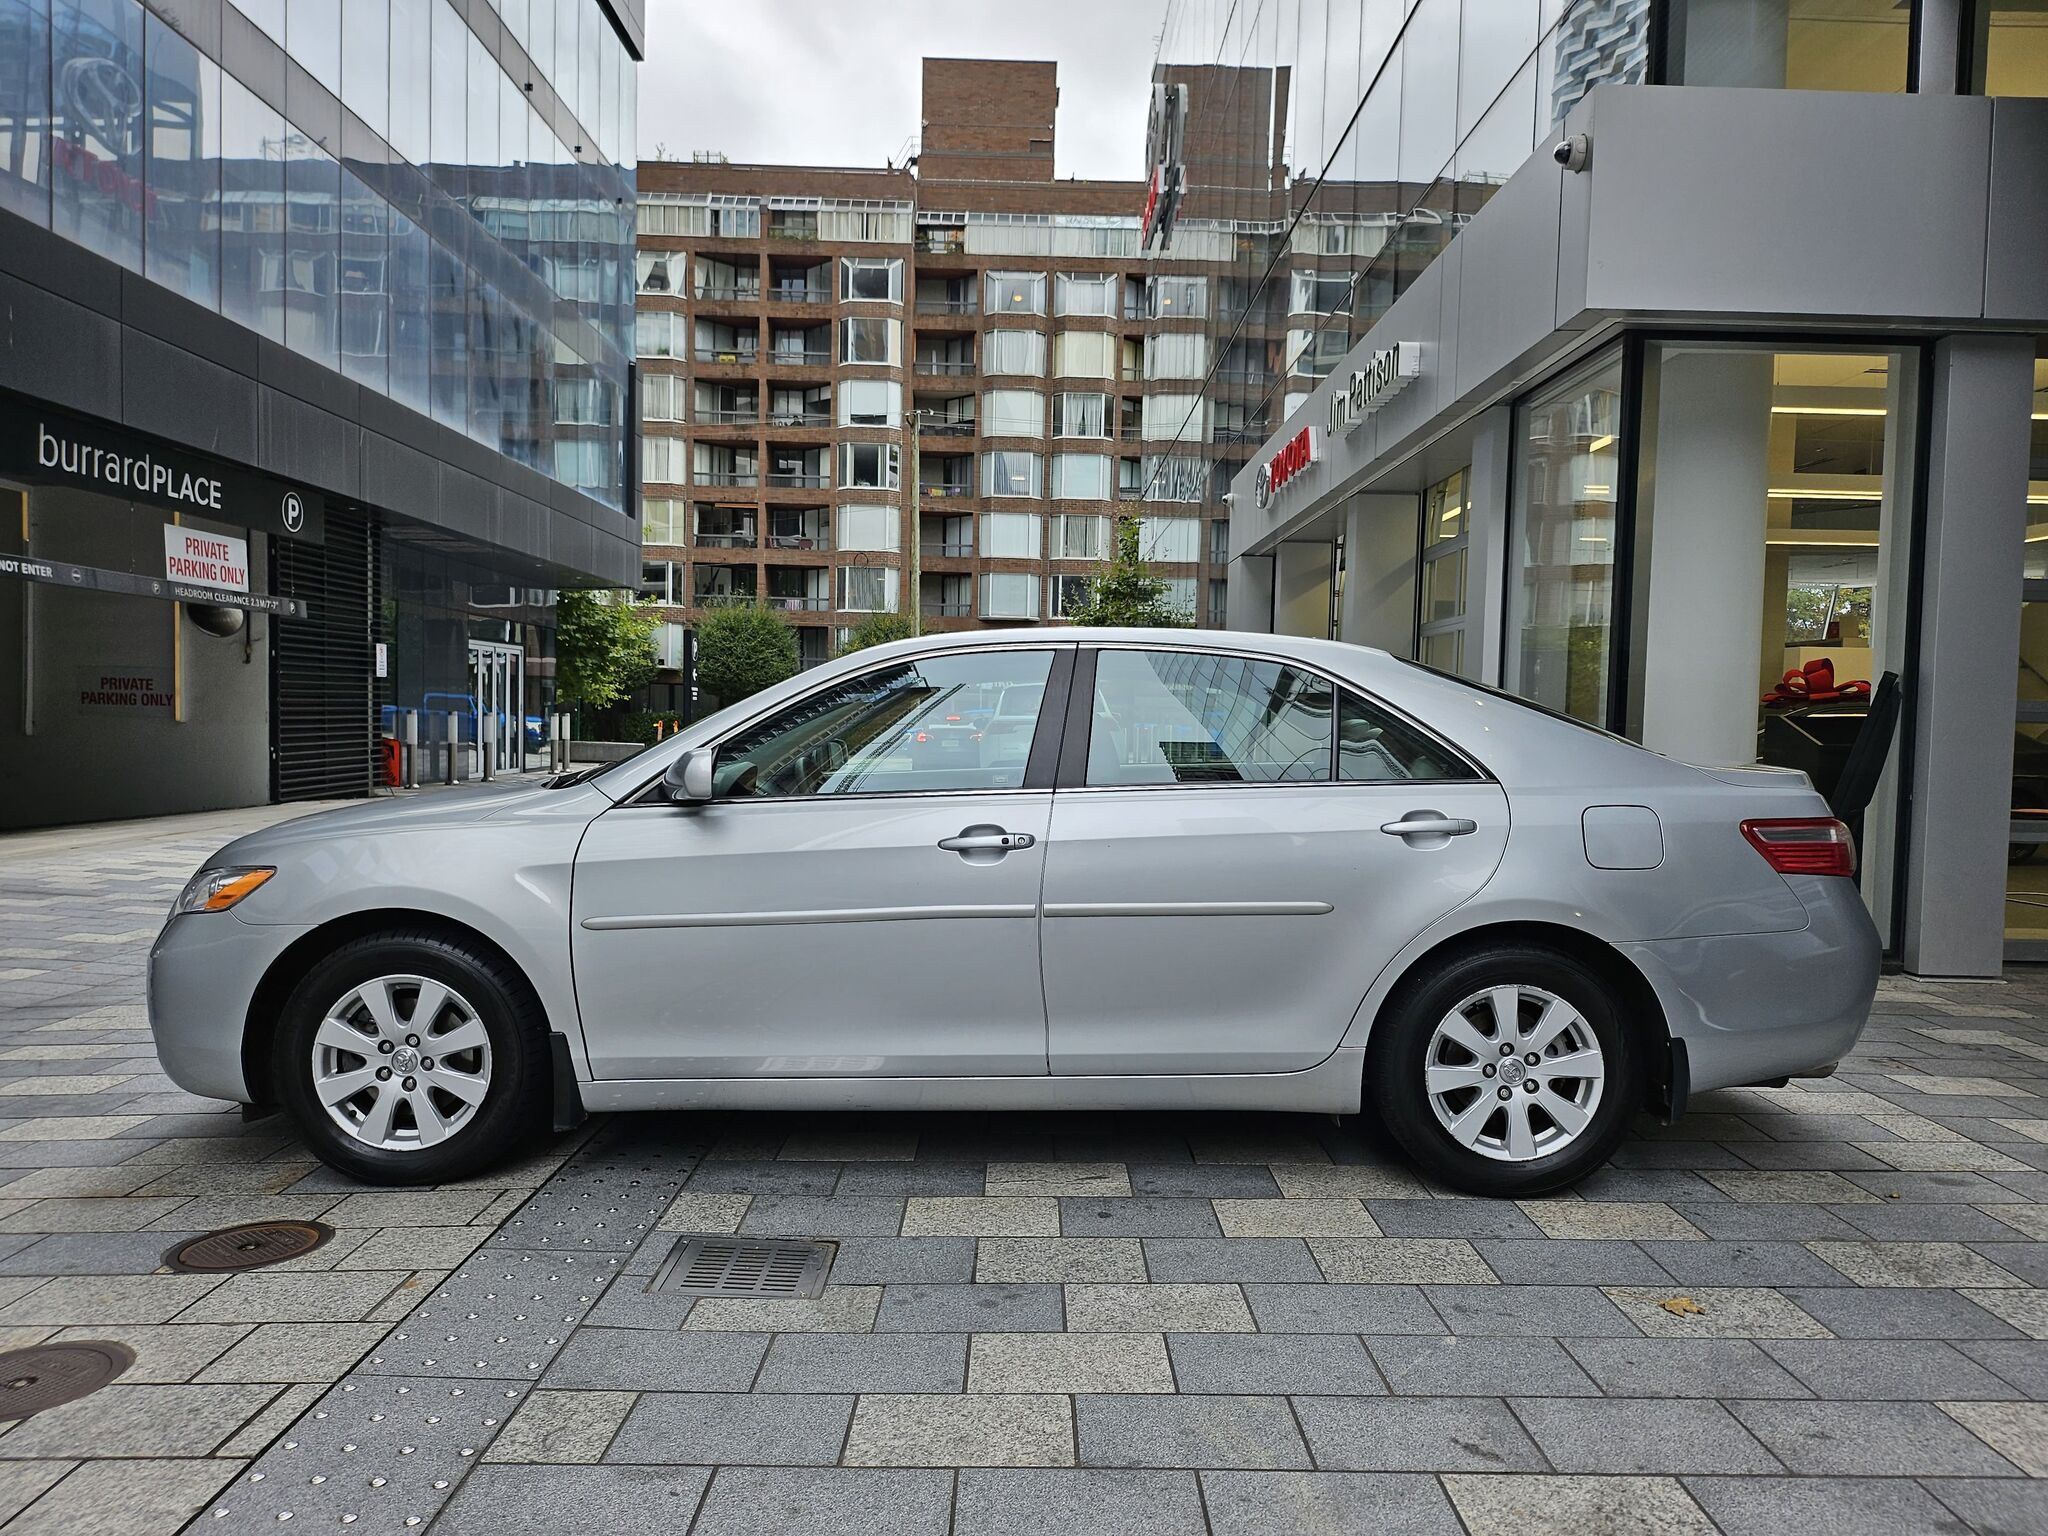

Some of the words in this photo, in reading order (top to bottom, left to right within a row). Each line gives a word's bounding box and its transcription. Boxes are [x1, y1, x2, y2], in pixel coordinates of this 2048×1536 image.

[1327, 391, 1346, 437] Jim
[1350, 341, 1400, 419] Pattison
[38, 422, 222, 509] burrardPLACE
[1270, 425, 1311, 493] TOYOTA
[185, 537, 229, 561] PRIVATE
[0, 560, 19, 573] NOT
[21, 562, 53, 578] ENTER
[169, 556, 217, 581] PARKING
[220, 565, 245, 585] ONLY
[174, 586, 213, 601] HEADROOM
[214, 592, 250, 606] CLEARANCE
[100, 677, 154, 691] PRIVATE
[80, 691, 138, 706] PARKING
[141, 692, 174, 706] ONLY
